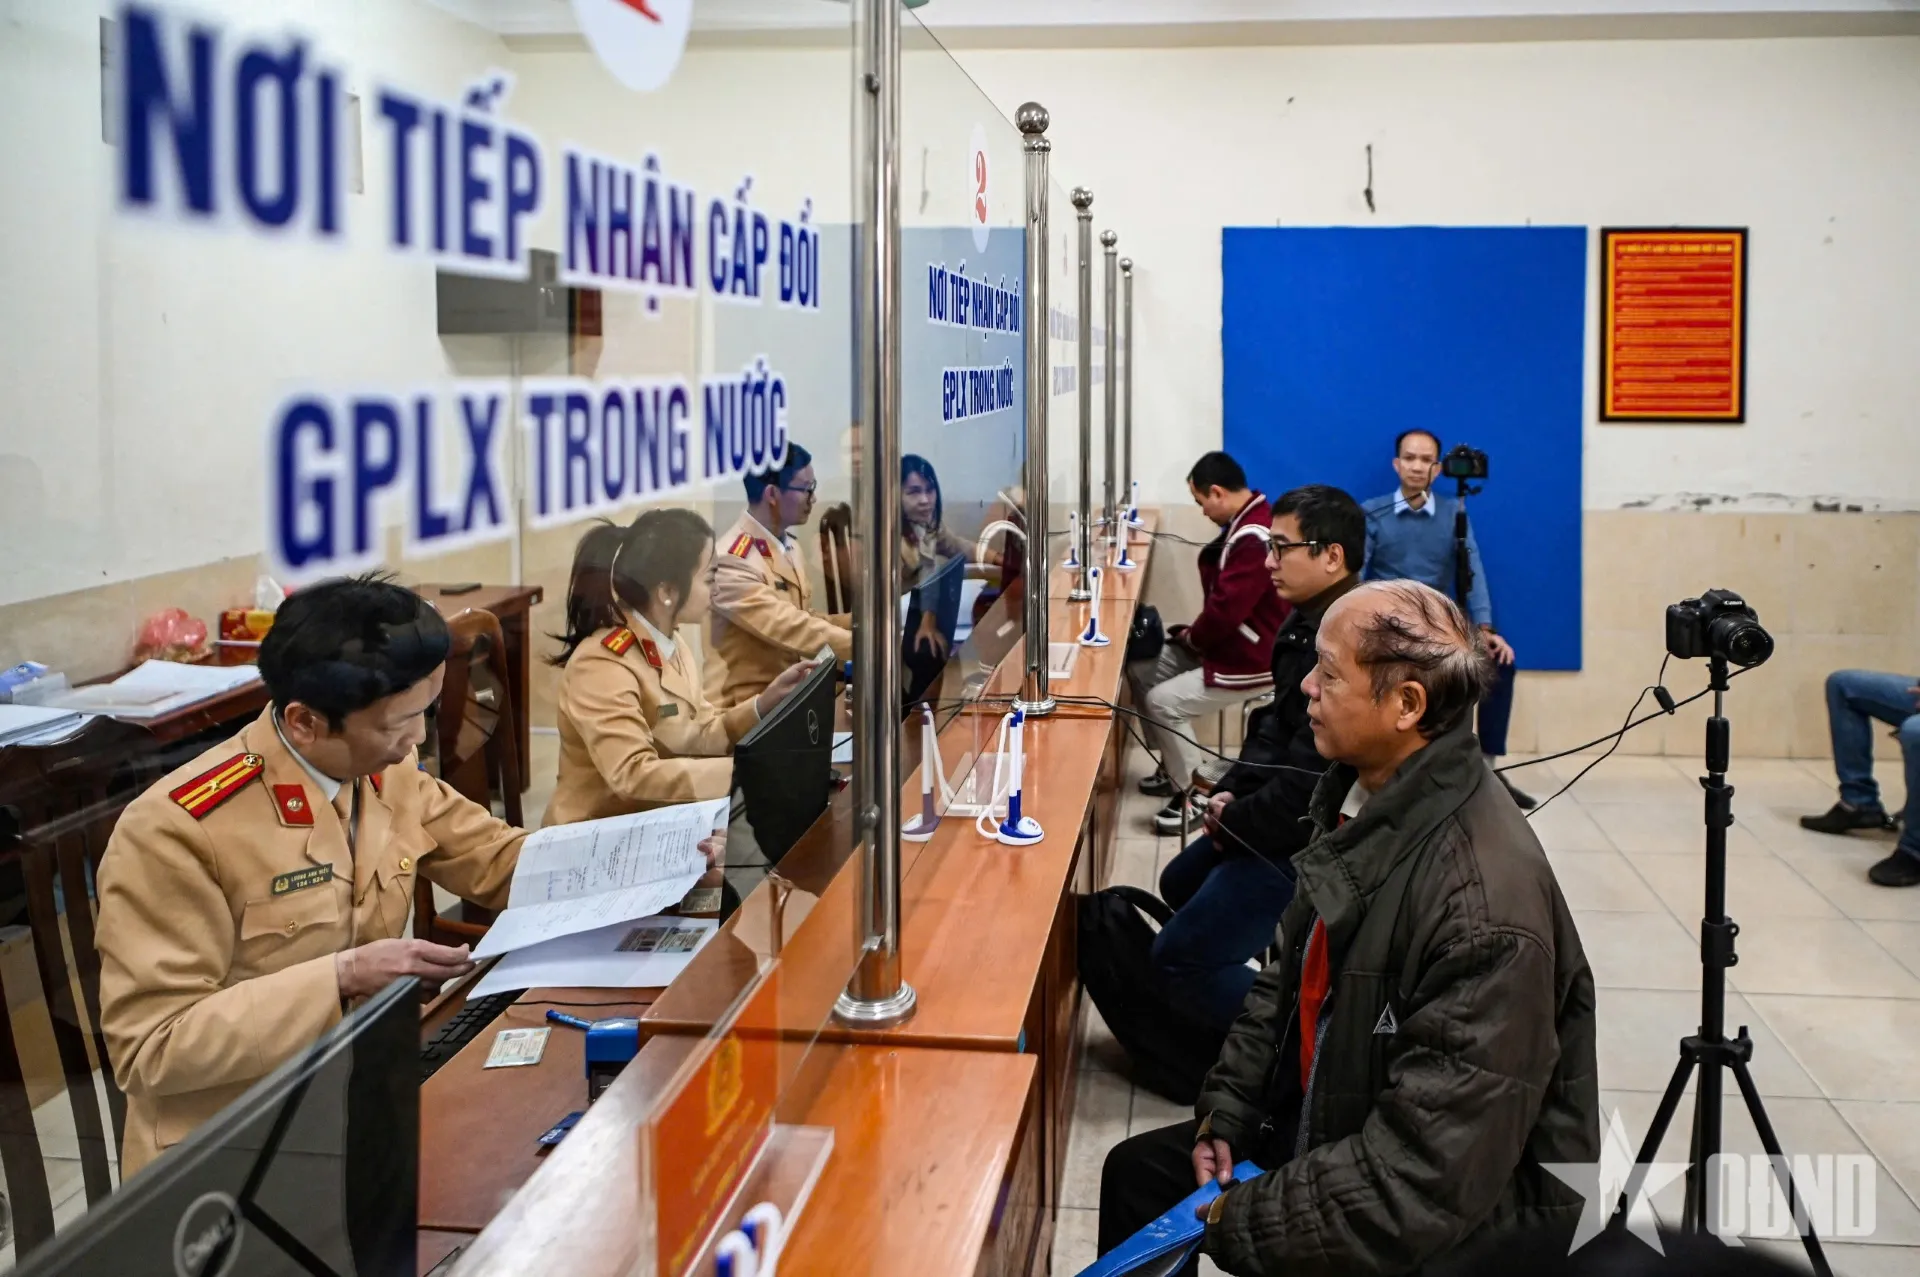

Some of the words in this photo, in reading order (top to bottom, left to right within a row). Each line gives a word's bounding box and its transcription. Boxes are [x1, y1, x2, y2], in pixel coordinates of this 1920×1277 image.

[122, 5, 337, 233] NƠI
[377, 78, 540, 263] TIẾP
[566, 152, 695, 311] NHẬN
[708, 176, 768, 298] CẤP
[779, 197, 819, 308] ĐỔI
[975, 150, 987, 224] 2
[928, 265, 948, 321] NƠI
[950, 263, 970, 325] TIẾP
[972, 276, 994, 339] NHẬN
[995, 276, 1009, 331] CẤP
[943, 370, 967, 421] GPLX
[969, 369, 995, 416] TRONG
[996, 358, 1014, 409] NƯỚC
[278, 396, 504, 568] GPLX
[528, 386, 691, 517] TRONG
[703, 359, 786, 478] NƯỚC
